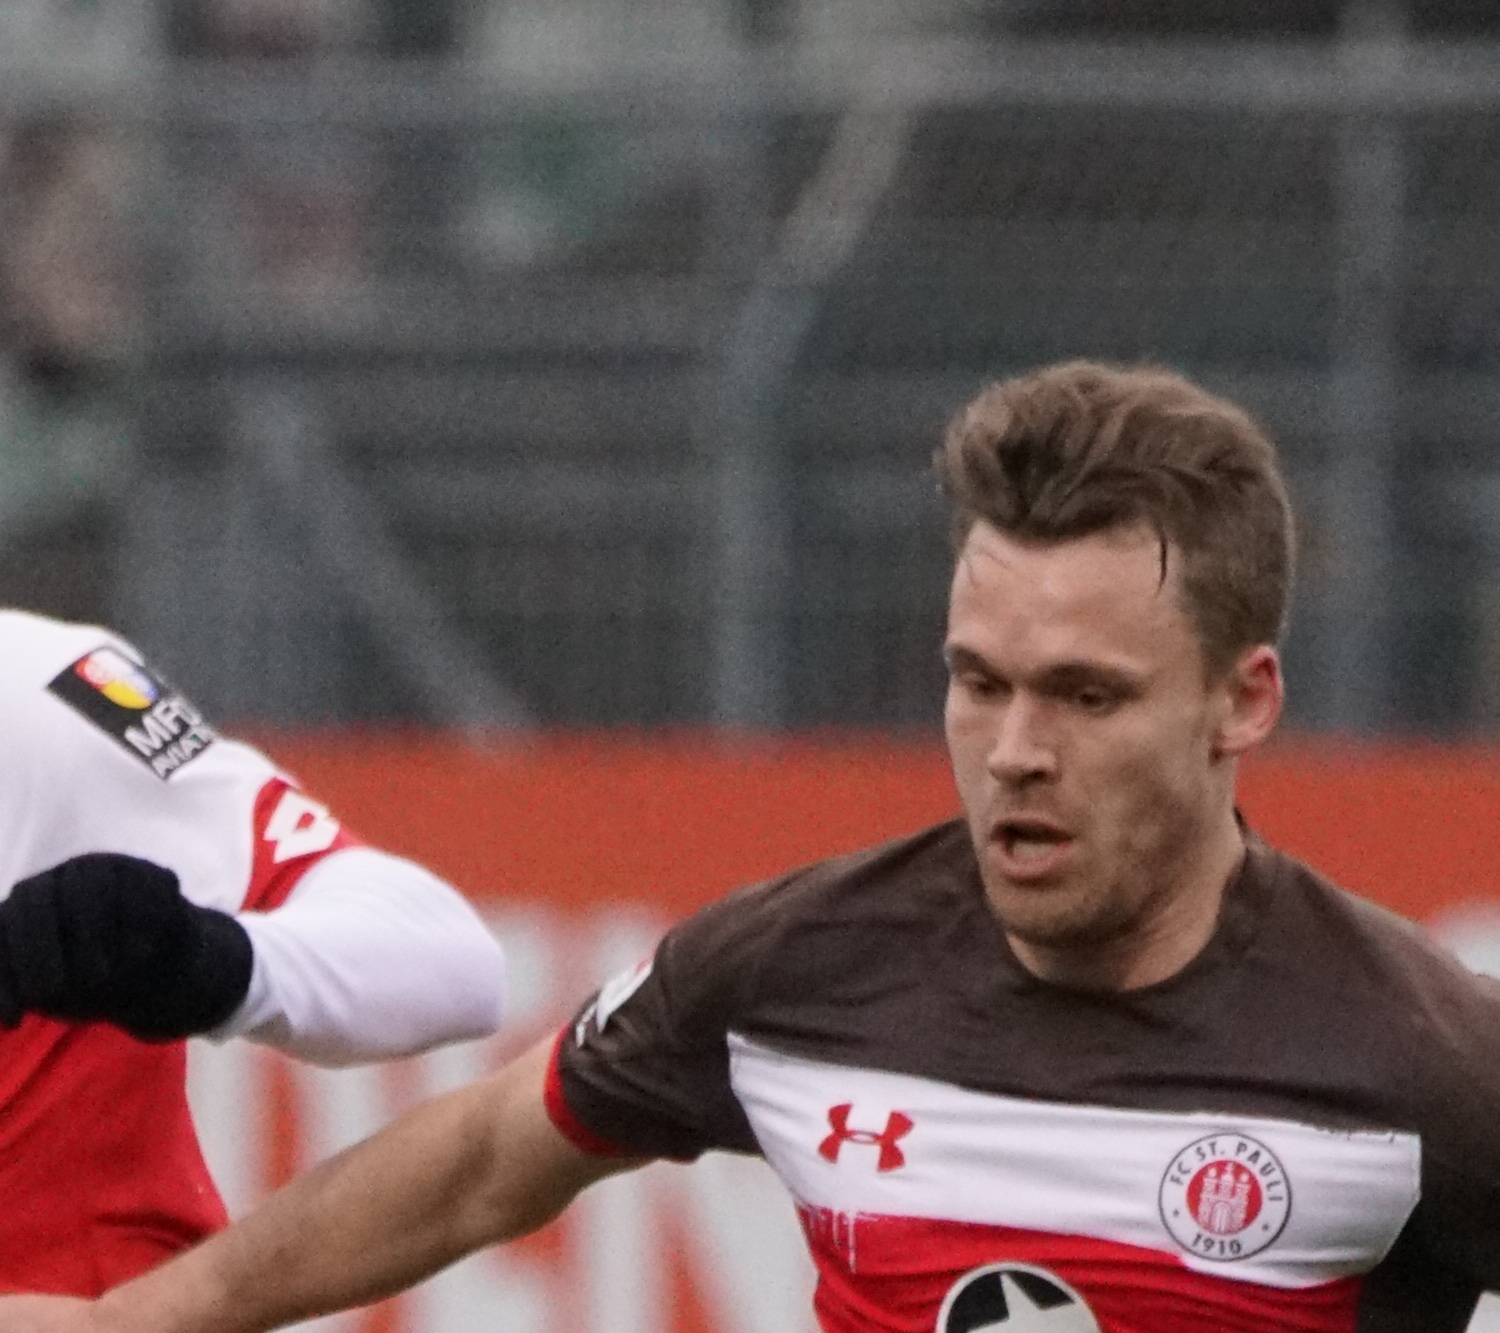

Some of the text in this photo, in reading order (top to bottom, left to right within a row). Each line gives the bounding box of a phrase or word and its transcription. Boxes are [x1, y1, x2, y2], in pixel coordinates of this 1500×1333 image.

[1170, 1161, 1191, 1186] FC
[1235, 1141, 1284, 1202] PAULI
[1191, 1233, 1242, 1256] 1910
